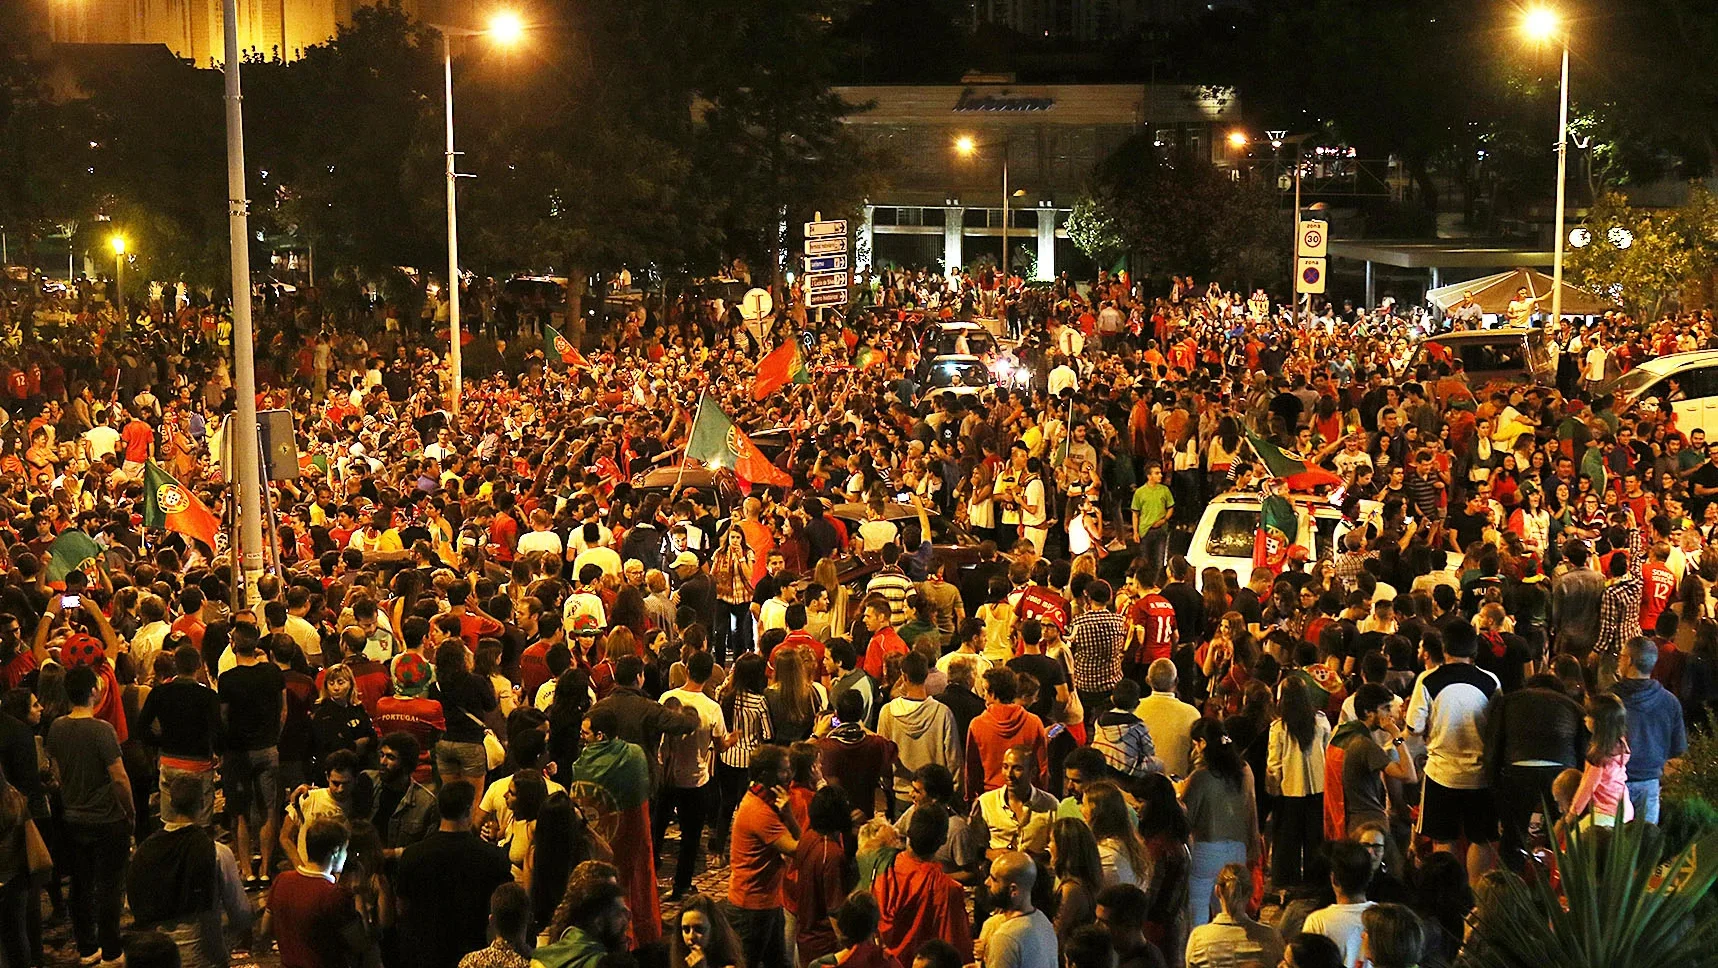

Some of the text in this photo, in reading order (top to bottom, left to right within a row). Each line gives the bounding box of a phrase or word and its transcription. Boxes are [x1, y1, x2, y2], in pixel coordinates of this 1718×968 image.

[1307, 235, 1319, 243] 30
[15, 375, 25, 387] 12
[1654, 582, 1669, 600] 12
